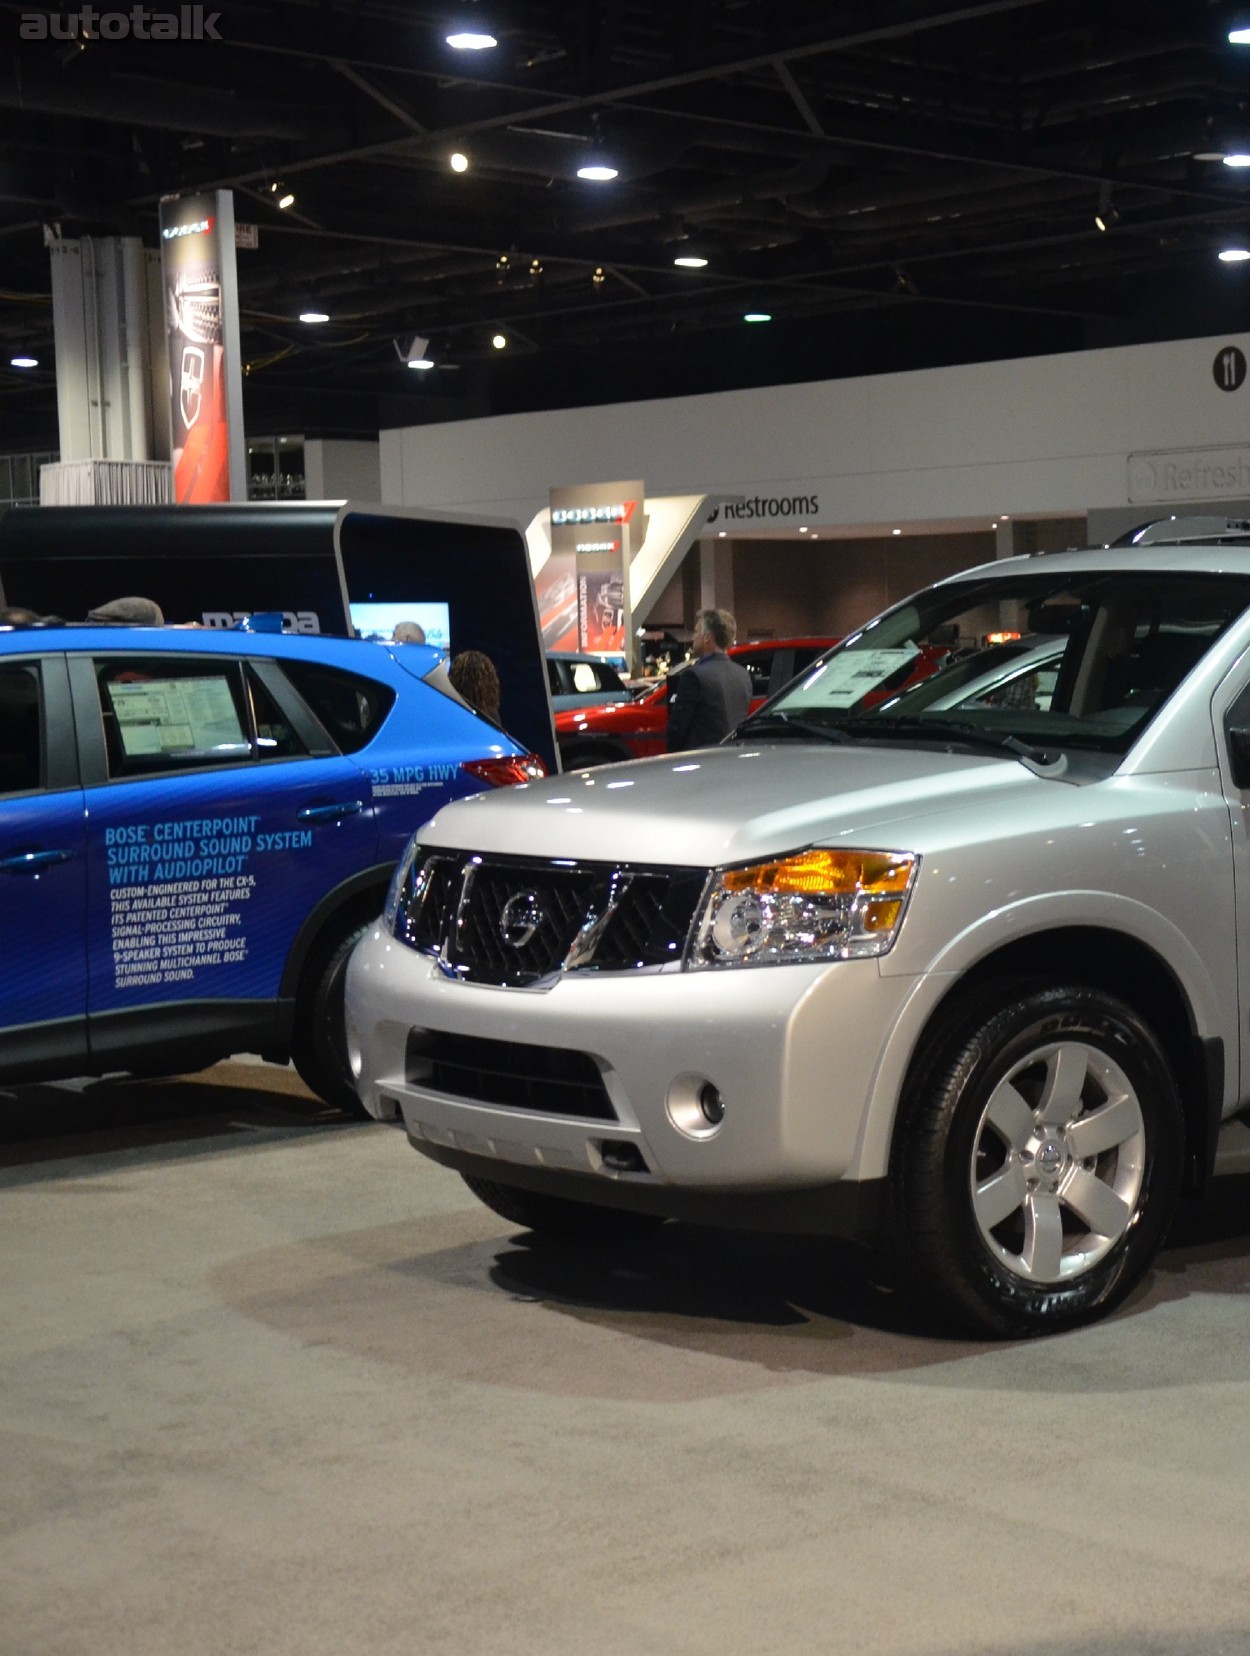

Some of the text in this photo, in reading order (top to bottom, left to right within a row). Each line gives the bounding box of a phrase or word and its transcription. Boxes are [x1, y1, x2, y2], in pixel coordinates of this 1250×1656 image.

[202, 611, 320, 634] mda
[579, 575, 588, 649] INFORMATION
[370, 764, 458, 784] 35 MPG HWY
[107, 830, 313, 865] SURROUND SOUND SYSTEM
[109, 864, 149, 885] WITH
[110, 875, 256, 899] CUSTOM-ENGINEERED FOR THE CX-5,
[111, 887, 250, 912] THIS AVAILABLE SYSTEM FEATURES
[111, 912, 125, 925] ITS
[126, 908, 168, 923] PATENTED
[112, 913, 241, 937] SIGNAL-PROCESSING CIRCUITRY,
[113, 927, 226, 950] ENABLING THIS IMPRESSIVE
[113, 937, 247, 963] 9-SPEAKER SYSTEM TO PRODUCE
[115, 961, 159, 976] STUNNING
[160, 953, 222, 970] MULTICHANNEL
[115, 968, 194, 988] SURROUND SOUND.
